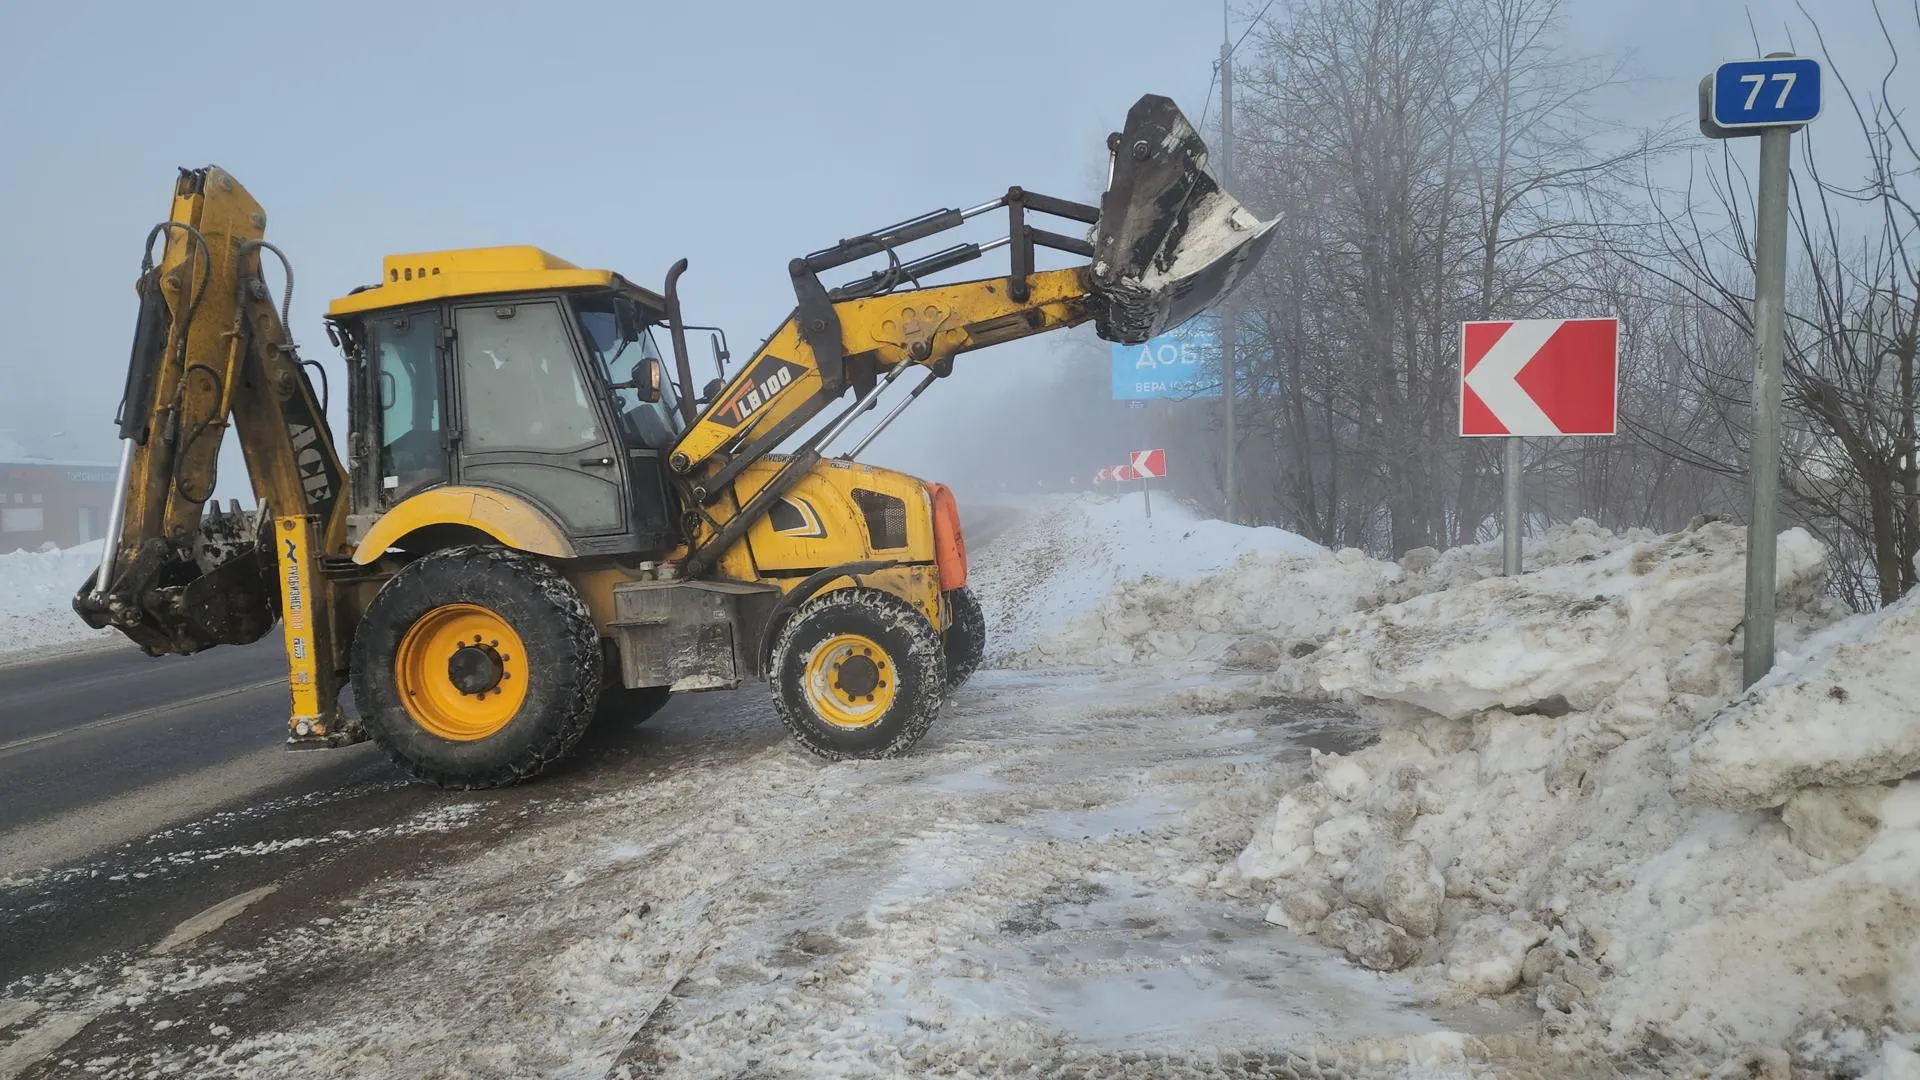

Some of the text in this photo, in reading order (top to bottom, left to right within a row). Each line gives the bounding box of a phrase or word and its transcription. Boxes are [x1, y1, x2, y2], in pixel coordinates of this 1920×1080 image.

[1740, 72, 1797, 110] 77
[717, 366, 792, 422] TLB 100
[1135, 382, 1168, 392] ВЕРА
[287, 423, 332, 505] ACE
